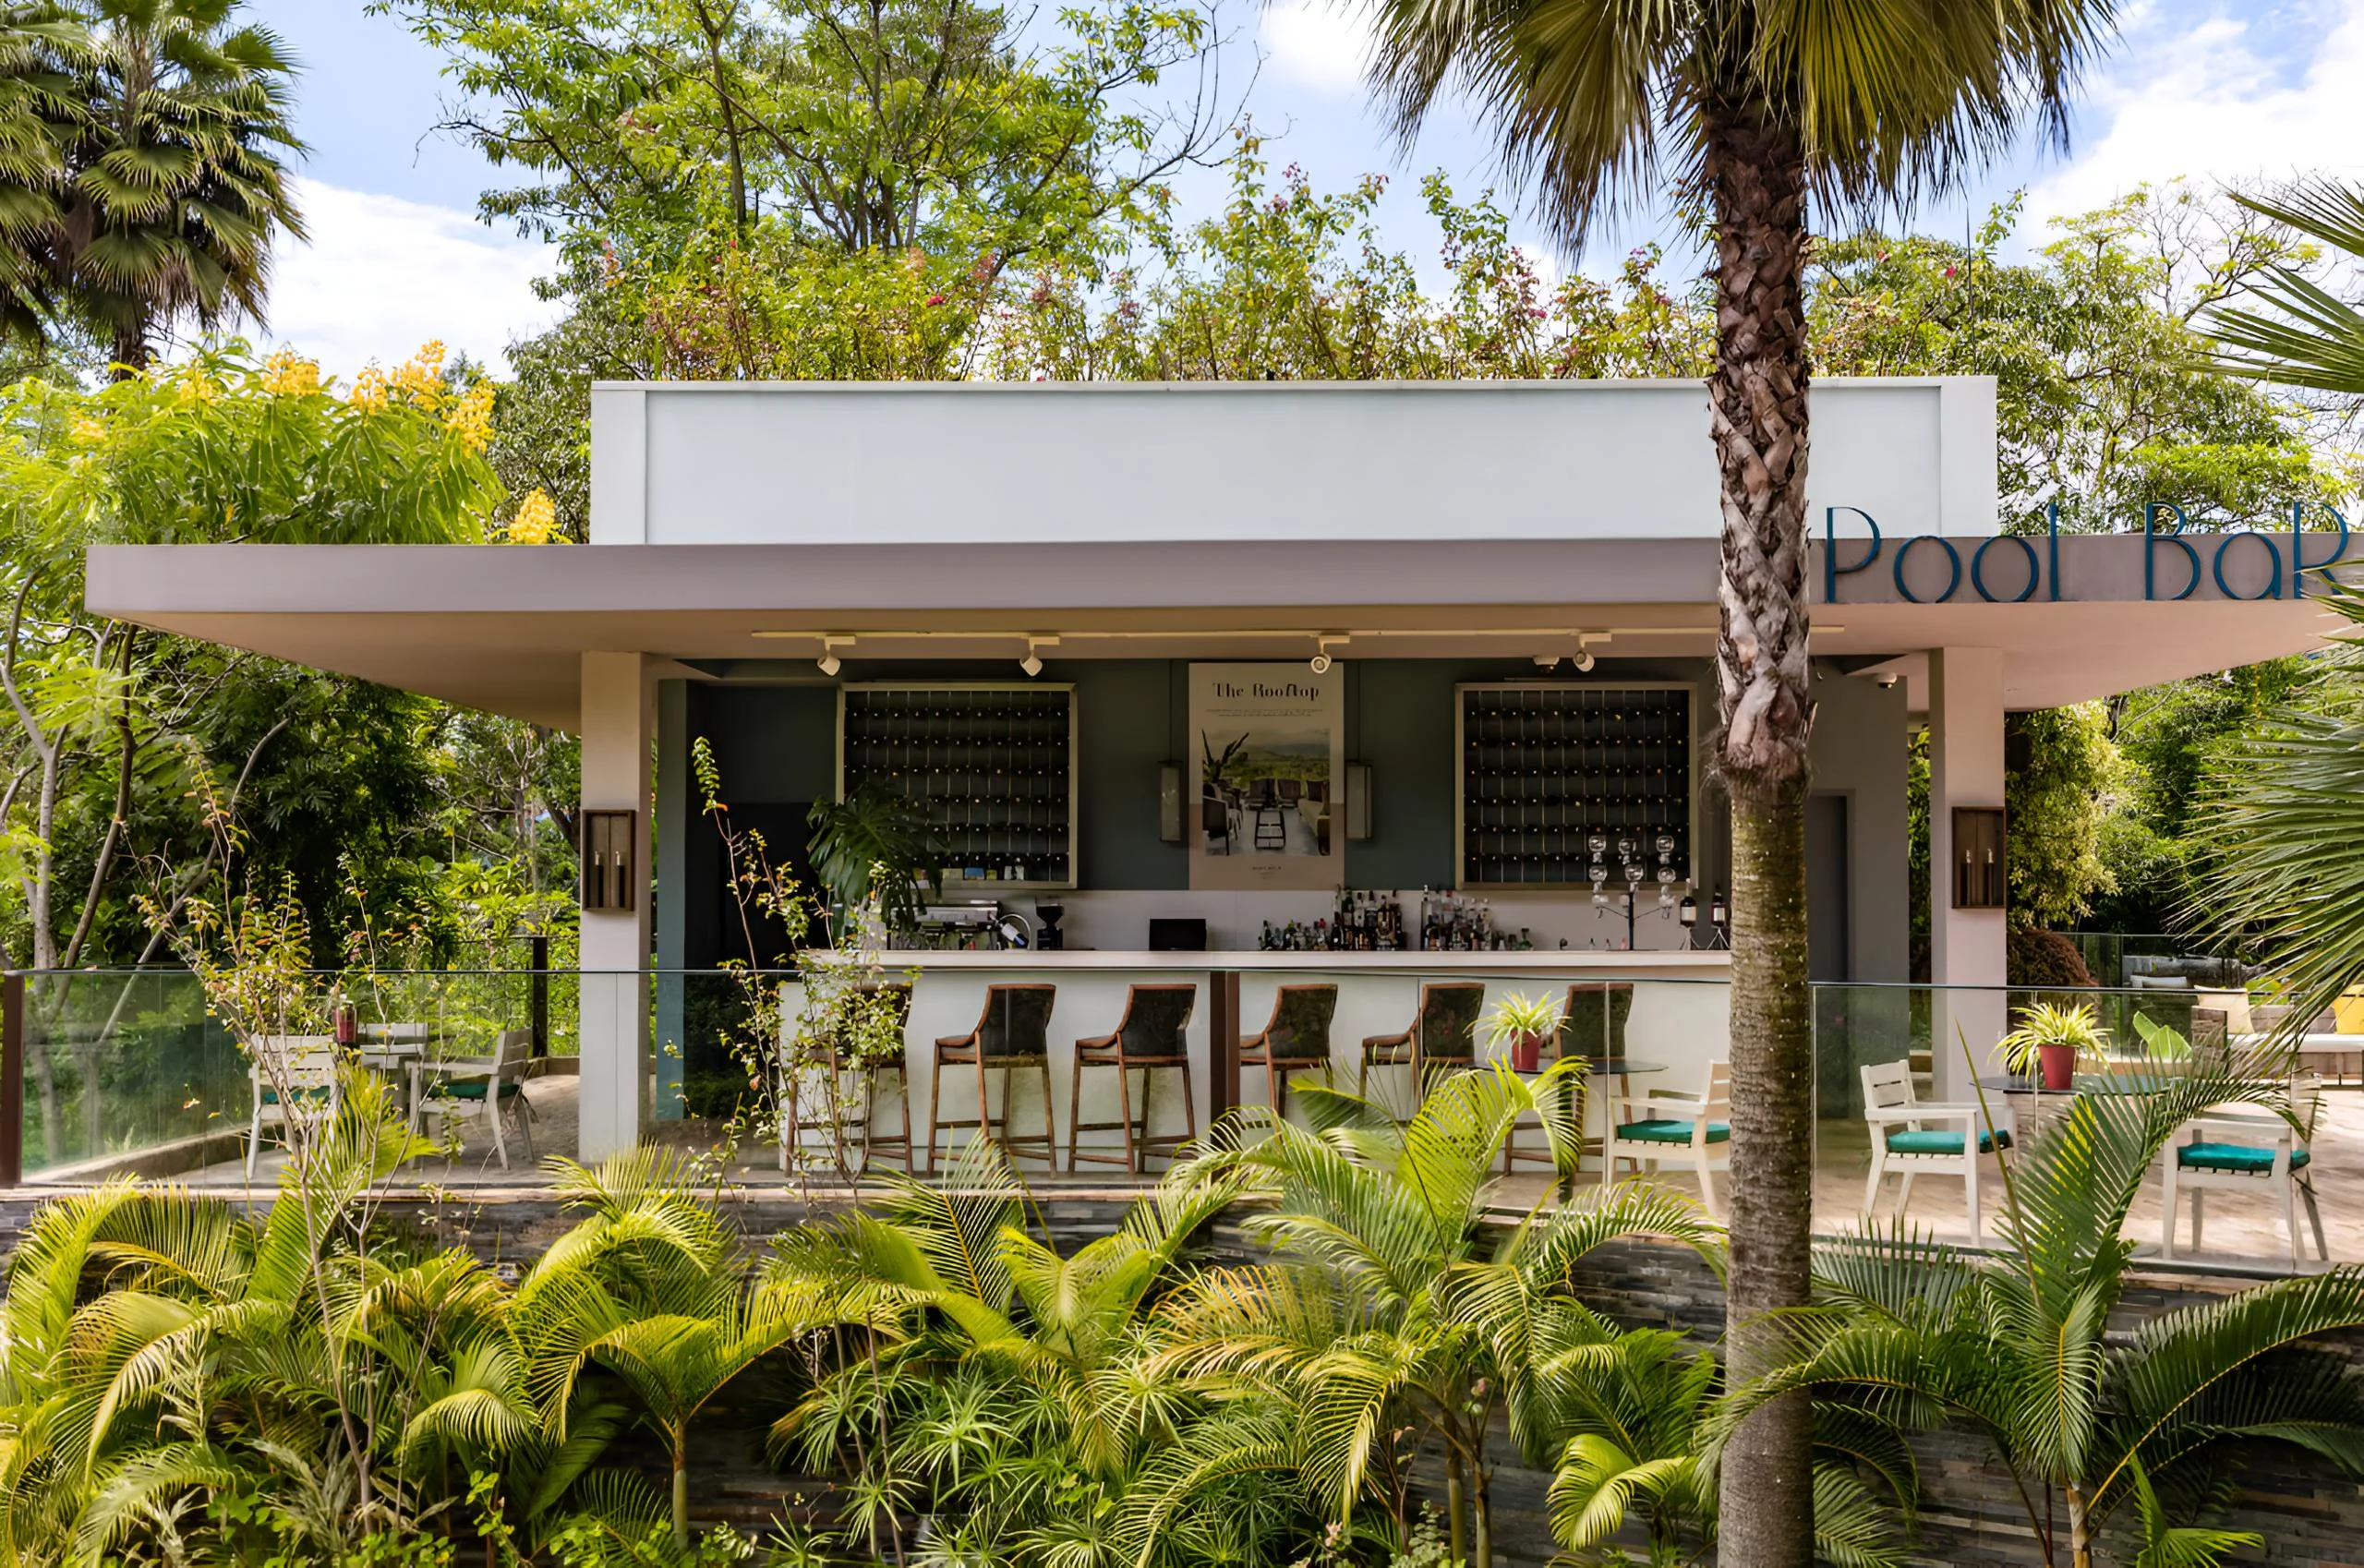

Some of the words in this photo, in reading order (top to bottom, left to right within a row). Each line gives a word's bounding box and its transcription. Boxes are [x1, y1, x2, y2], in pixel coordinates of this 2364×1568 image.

[1826, 501, 2059, 603] Pool
[1212, 682, 1245, 698] The
[1253, 682, 1320, 702] Rooftop
